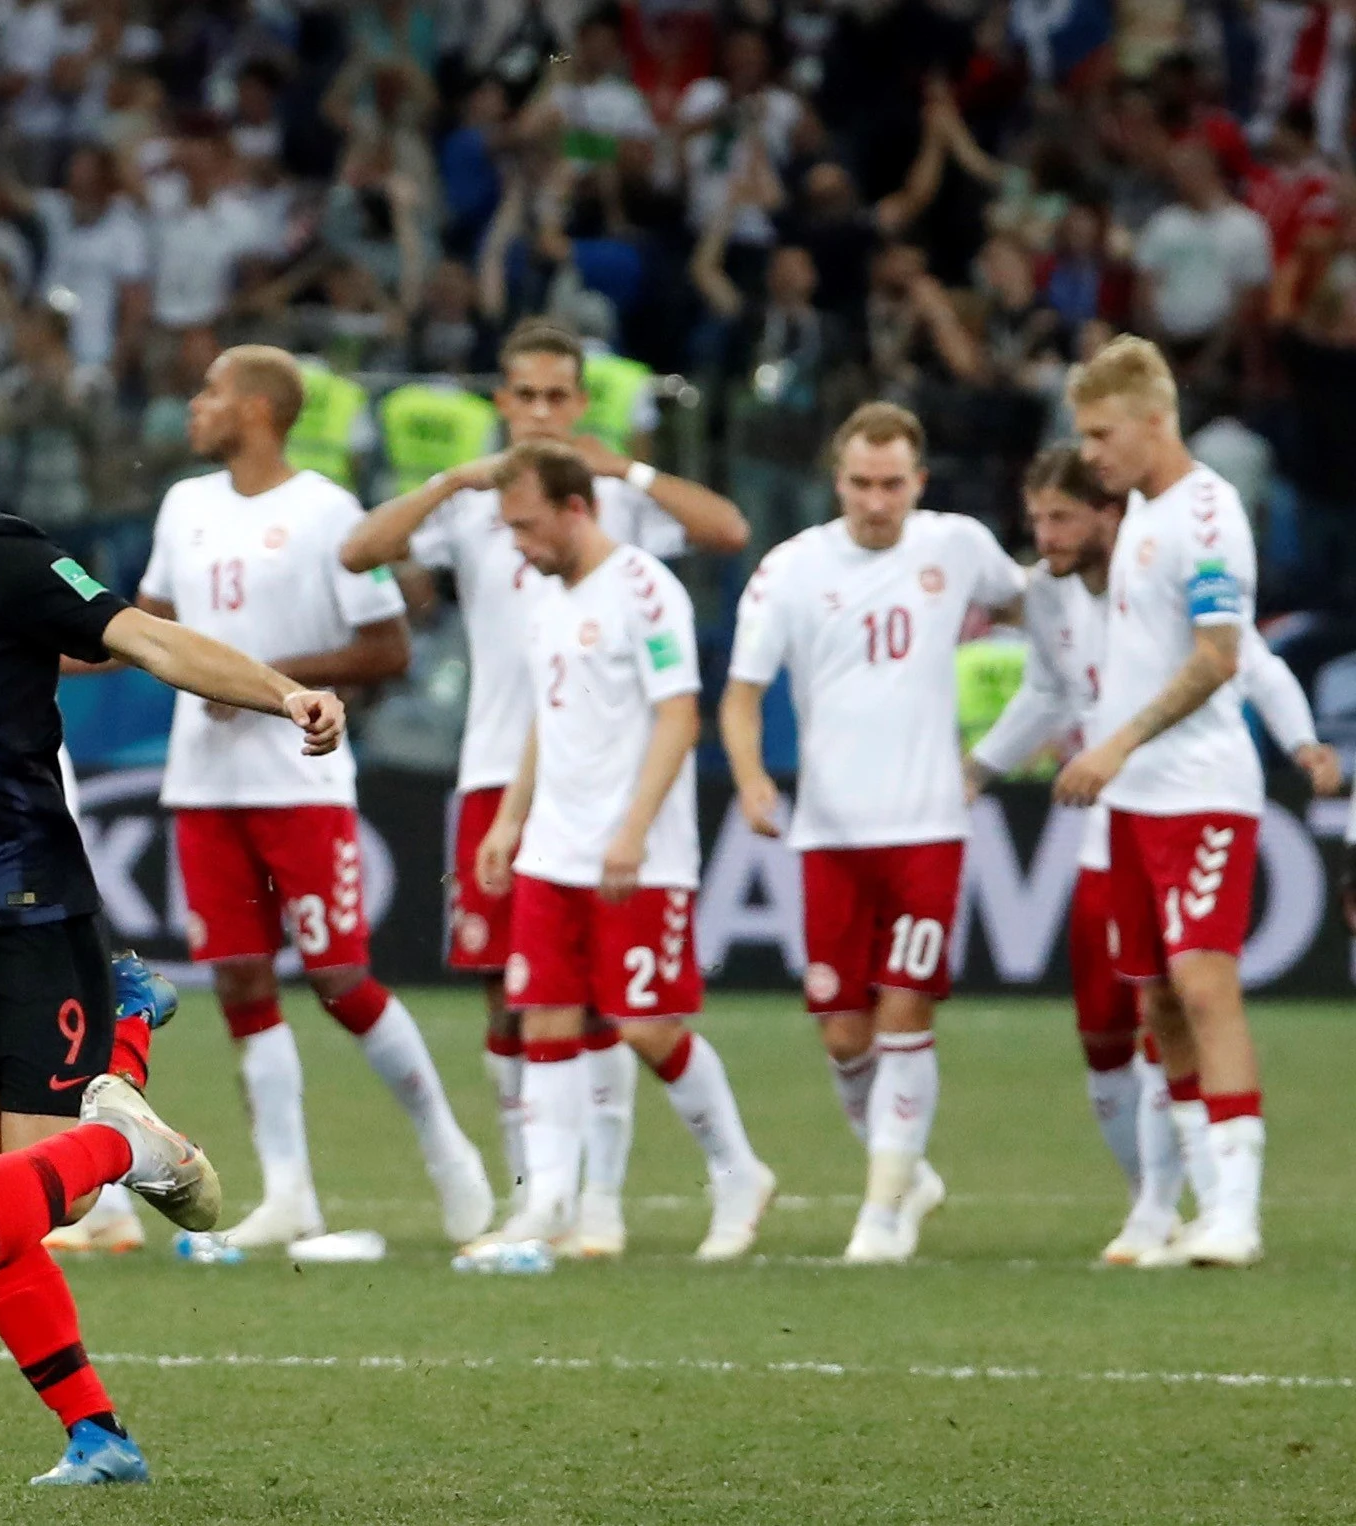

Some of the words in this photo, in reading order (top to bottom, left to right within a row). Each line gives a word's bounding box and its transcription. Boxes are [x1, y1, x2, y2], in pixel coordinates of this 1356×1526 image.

[209, 557, 246, 612] 13
[861, 606, 912, 665] 10
[548, 653, 567, 709] 2
[623, 946, 659, 1008] 2
[887, 913, 945, 981] 10
[58, 998, 86, 1065] 9
